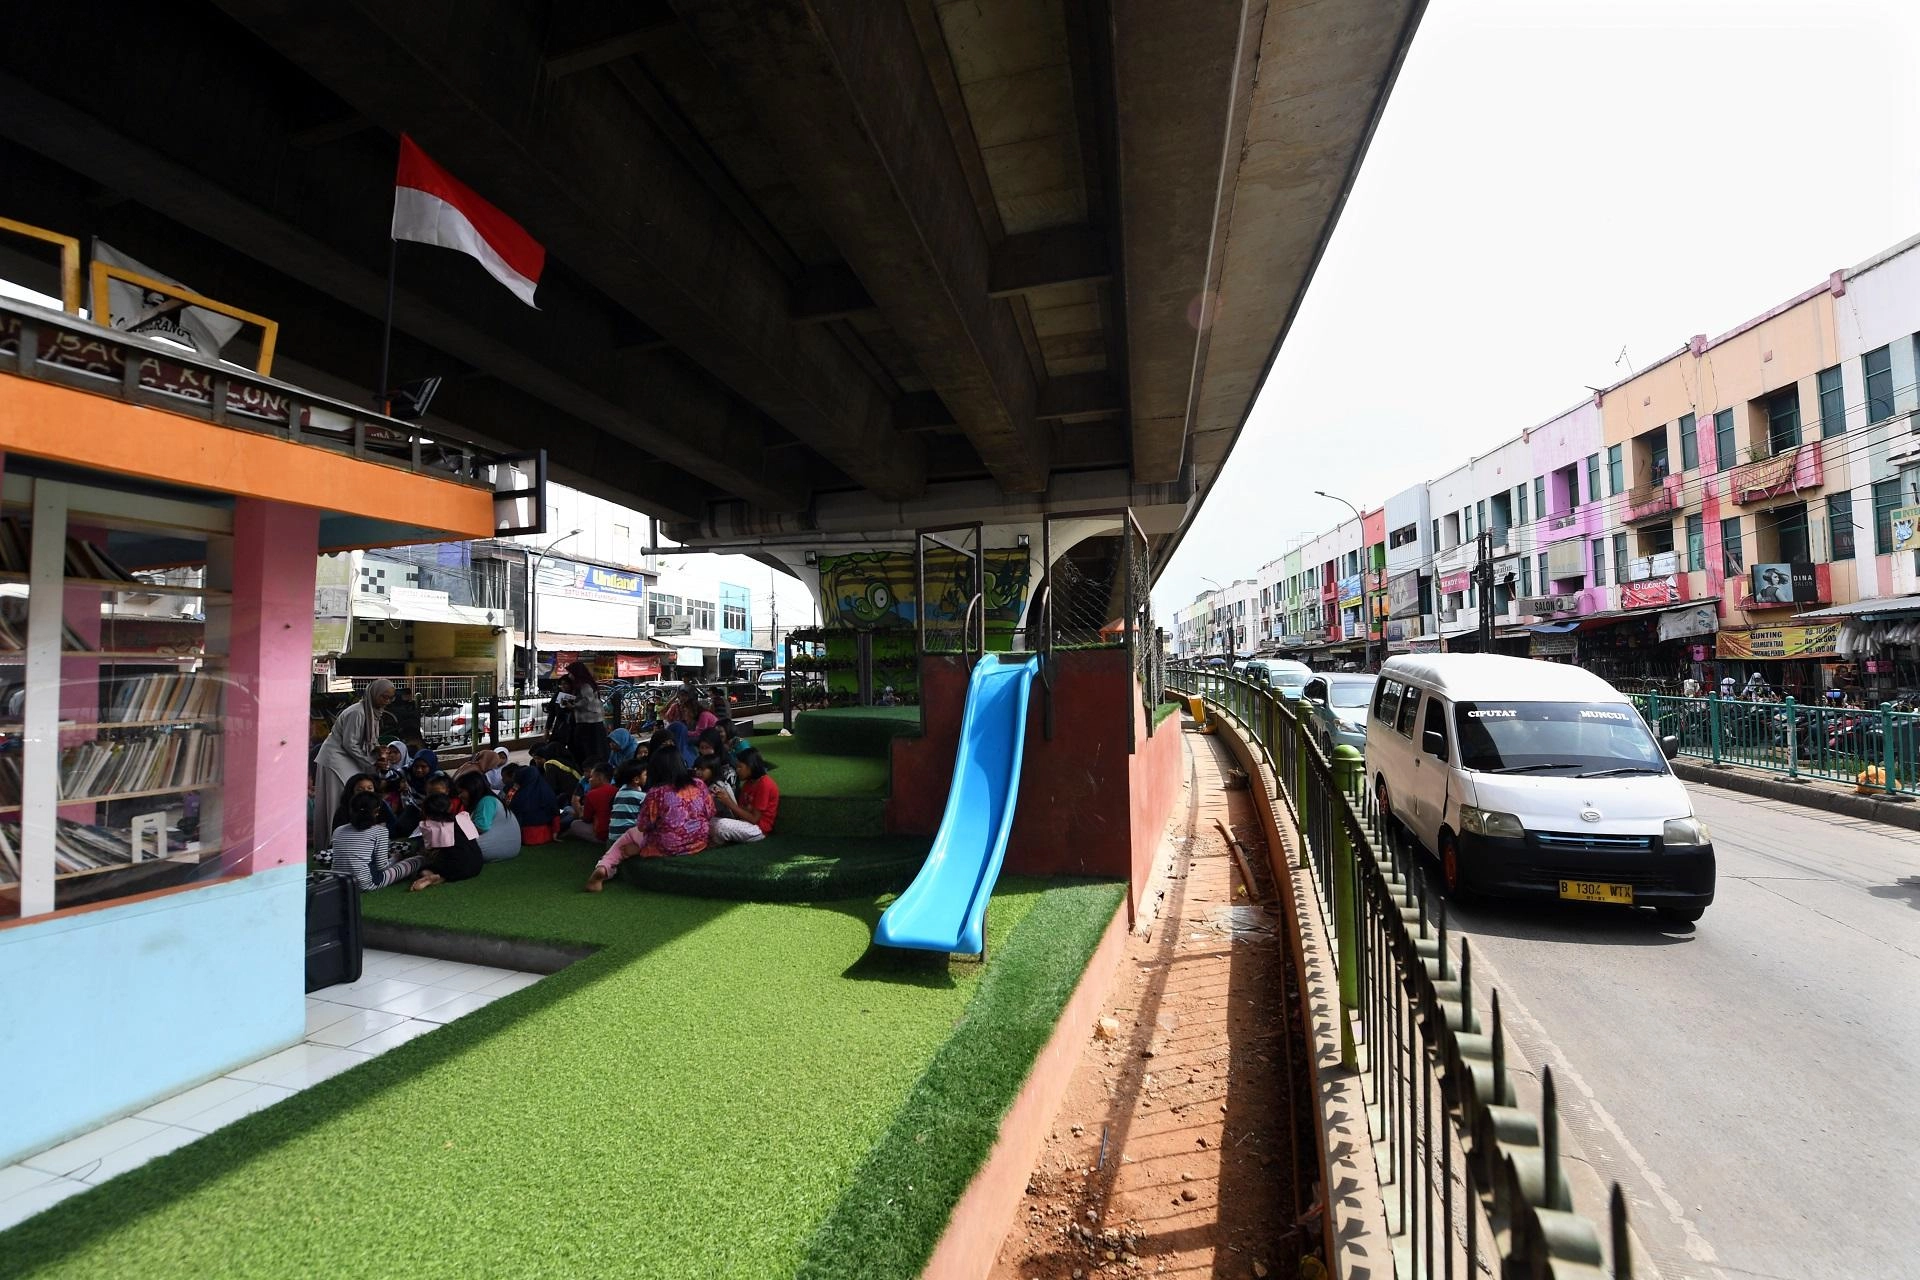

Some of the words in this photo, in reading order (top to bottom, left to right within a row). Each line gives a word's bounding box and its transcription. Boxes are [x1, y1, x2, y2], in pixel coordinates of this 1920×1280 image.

[593, 569, 637, 591] Uniland
[1534, 600, 1555, 612] SALON
[1750, 631, 1782, 640] GUNTING
[1467, 710, 1517, 718] CIPUTAT
[1580, 710, 1629, 721] MUNCUL
[1561, 882, 1568, 893] B
[1610, 885, 1631, 898] WTX
